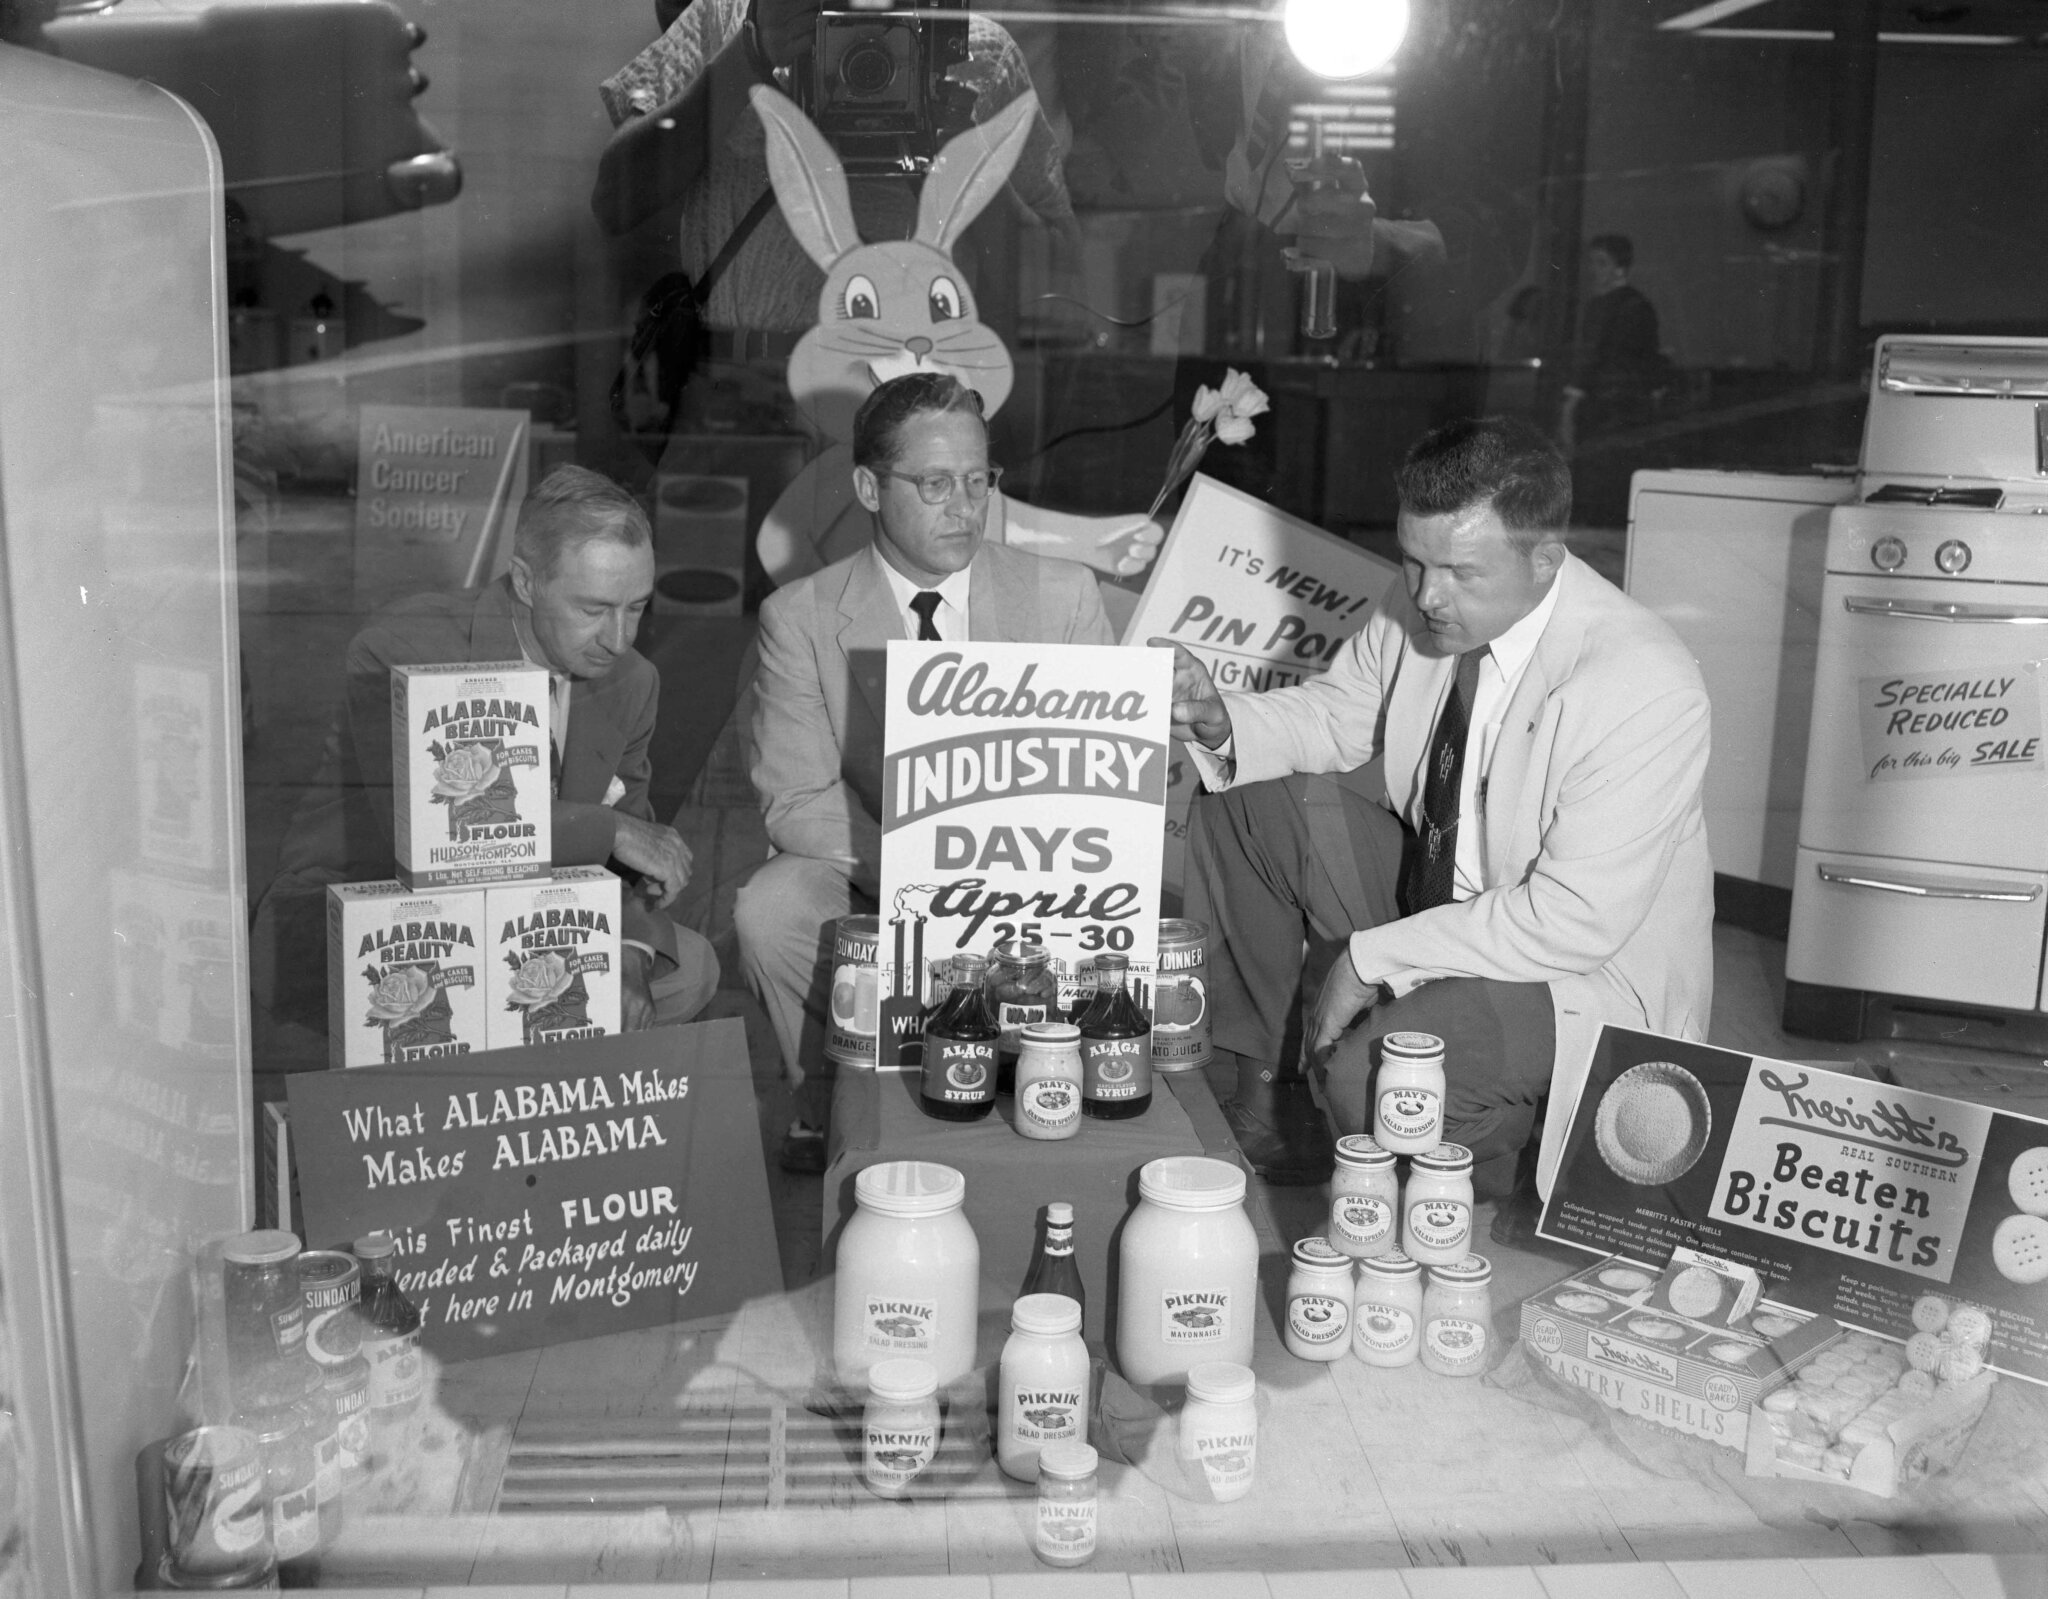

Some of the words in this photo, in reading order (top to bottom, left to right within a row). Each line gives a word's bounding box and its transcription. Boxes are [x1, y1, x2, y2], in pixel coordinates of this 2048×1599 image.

[373, 423, 496, 456] American
[371, 458, 464, 491] Cancer
[370, 498, 467, 539] Society
[1218, 545, 1264, 576] IT'S
[1265, 566, 1368, 621] NEW!
[907, 652, 1149, 722] Alabama
[1874, 677, 2015, 708] SPECIALLY
[423, 699, 540, 735] ALABAMA
[1886, 707, 2008, 736] REDUCED
[445, 719, 518, 740] BEAUTY
[496, 750, 509, 761] FOR
[511, 748, 534, 756] CAKES
[508, 755, 538, 764] BISCUITS
[1870, 754, 1897, 779] for
[1903, 751, 1931, 767] this
[1936, 747, 1961, 769] big
[1970, 738, 2040, 763] SALE
[896, 737, 1155, 818] INDUSTRY
[471, 823, 537, 841] FLOUR
[430, 844, 480, 864] HUDSON
[474, 841, 536, 862] THOMPSON
[934, 825, 1113, 874] DAYS
[428, 873, 433, 881] 5
[451, 870, 463, 879] Net
[465, 867, 505, 877] SELF-RISING
[506, 864, 540, 873] BLEACHED
[500, 908, 611, 944] ALABAMA
[358, 921, 475, 958] ALABAMA
[521, 928, 591, 949] BEAUTY
[380, 942, 454, 963] BEAUTY
[838, 938, 876, 962] SUNDAY
[1163, 948, 1204, 971] DINNER
[569, 959, 581, 969] FOR
[583, 955, 604, 963] CAKES
[581, 962, 608, 970] BISCUITS
[432, 971, 445, 982] FOR
[447, 967, 468, 976] CAKES
[444, 976, 473, 985] BISCUITS
[406, 1042, 471, 1061] FLOUR
[832, 1035, 871, 1051] ORANGE
[943, 1043, 994, 1059] ALAGA
[1089, 1041, 1140, 1057] ALAGA
[1172, 1042, 1203, 1057] JUICE
[944, 1090, 986, 1100] SYRUP
[1039, 1081, 1072, 1091] MAY'S
[1096, 1087, 1137, 1097] SYRUP
[1394, 1090, 1428, 1100] MAY'S
[342, 1102, 425, 1143] What
[442, 1075, 615, 1131] ALABAMA
[618, 1069, 689, 1105] Makes
[1383, 1114, 1403, 1132] SALAD
[1404, 1117, 1436, 1134] DRESSING
[362, 1147, 467, 1190] Makes
[492, 1114, 667, 1170] ALABAMA
[1840, 1145, 1876, 1166] REAL
[1886, 1155, 1958, 1184] SOUTHERN
[1773, 1142, 1930, 1218] Beaten
[1345, 1197, 1379, 1209] MAY'S
[1424, 1202, 1458, 1212] MAY'S
[447, 1208, 534, 1247] Finest
[561, 1185, 679, 1229] FLOUR
[1635, 1207, 1668, 1221] MERRITT'S
[1670, 1216, 1697, 1230] PASTRY
[1699, 1224, 1722, 1237] SHELLS
[1723, 1170, 1941, 1267] Biscuits
[1336, 1221, 1363, 1242] SANDWICH
[1363, 1228, 1385, 1243] SPREAD
[1413, 1226, 1434, 1244] SALAD
[1435, 1228, 1466, 1245] DRESSING
[1599, 1223, 1612, 1231] and
[1613, 1228, 1633, 1238] makes
[490, 1250, 511, 1278] &
[518, 1230, 625, 1275] Packaged
[635, 1220, 693, 1258] daily
[1628, 1220, 1648, 1231] tender
[1650, 1227, 1663, 1235] and
[1685, 1236, 1699, 1245] One
[1701, 1242, 1728, 1254] package
[1730, 1250, 1758, 1262] contains
[306, 1283, 351, 1309] SUNDAY
[445, 1290, 499, 1325] here
[508, 1279, 533, 1312] in
[549, 1258, 699, 1309] Montgomery
[1165, 1293, 1228, 1309] PIKNIK
[868, 1303, 933, 1320] PIKNIK
[1301, 1296, 1335, 1308] MAY'S
[1367, 1305, 1400, 1318] MAY'S
[1171, 1329, 1222, 1338] MAYONNAISE
[1292, 1319, 1310, 1339] SALAD
[1311, 1324, 1343, 1340] DRESSING
[1439, 1319, 1474, 1331] MAY'S
[1535, 1324, 1558, 1336] READY
[1537, 1335, 1561, 1345] BAKED
[1542, 1355, 1625, 1401] PASTRY
[1640, 1389, 1725, 1435] SHELLS
[1707, 1382, 1734, 1393] READY
[1017, 1393, 1080, 1406] PIKNIK
[1709, 1392, 1737, 1404] BAKED
[869, 1434, 932, 1447] PIKNIK
[1017, 1427, 1040, 1439] SALAD
[1043, 1428, 1076, 1440] DRESSING
[1196, 1434, 1256, 1451] PIKNIK
[1040, 1506, 1095, 1518] PIKNIK
